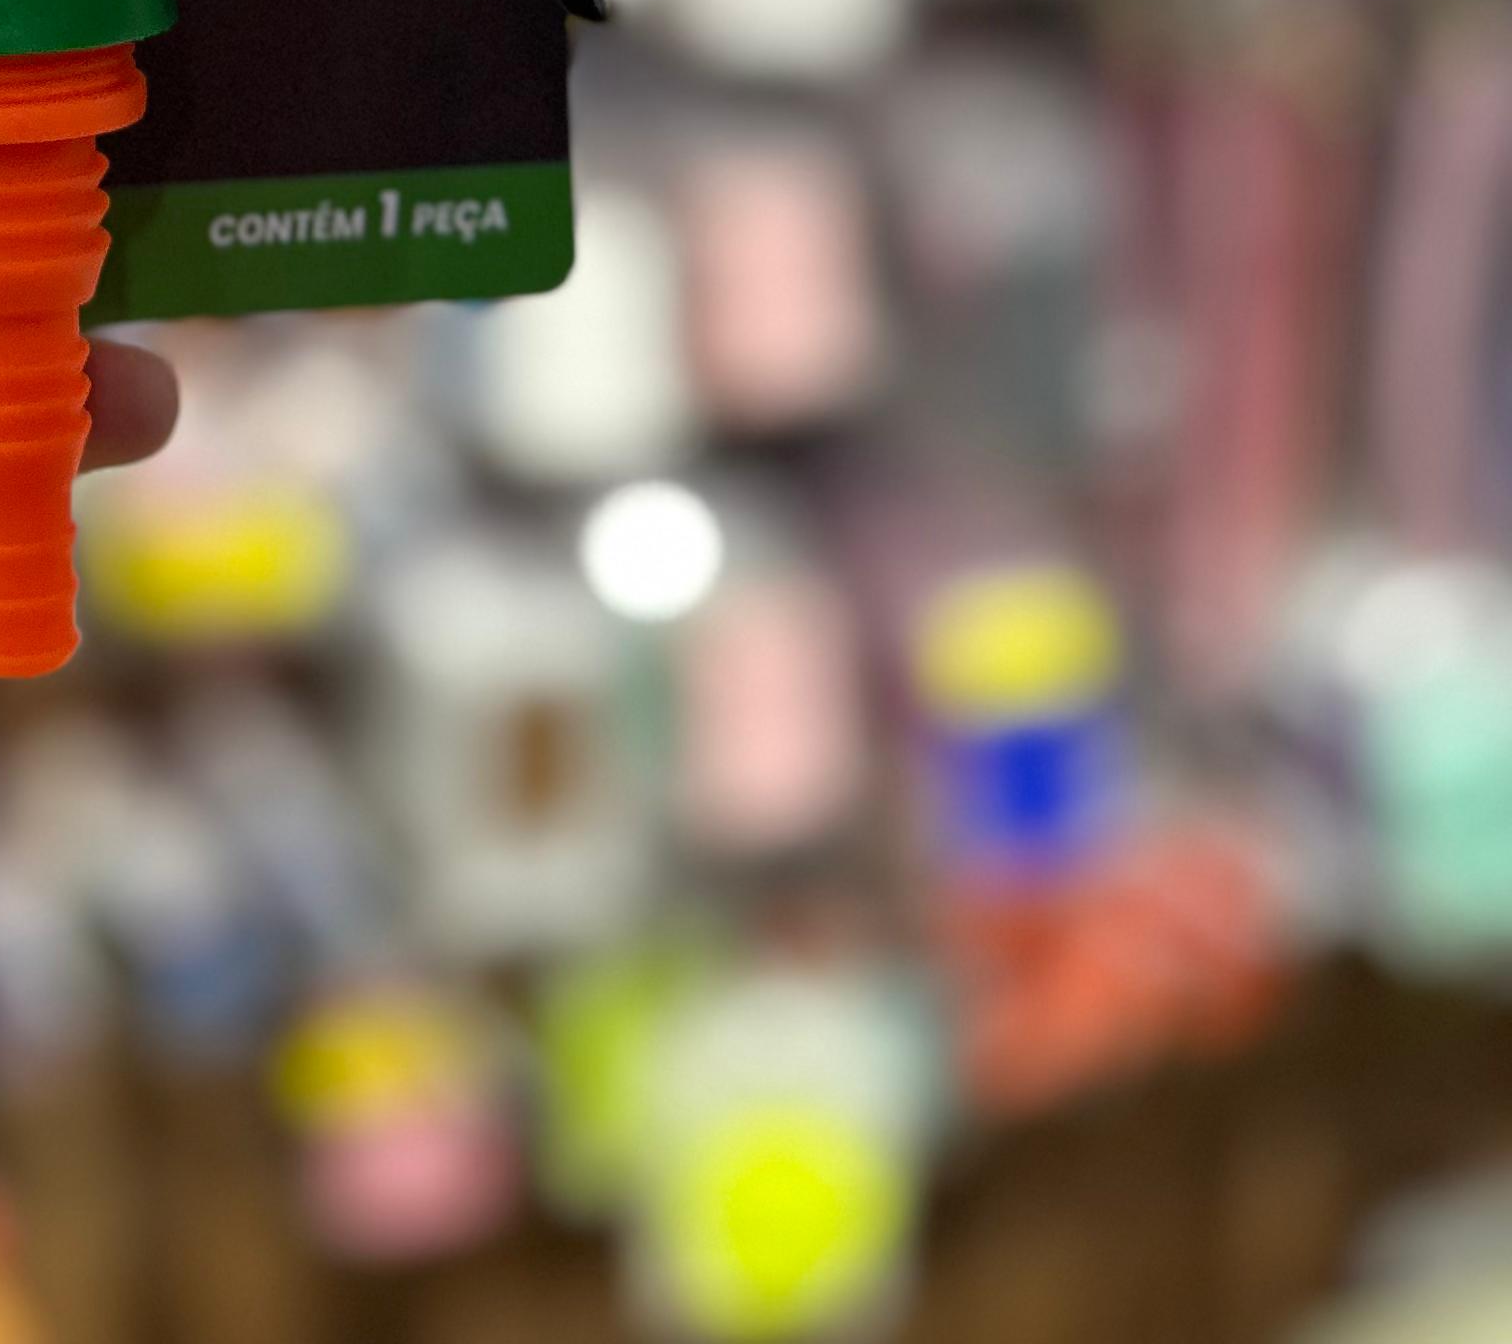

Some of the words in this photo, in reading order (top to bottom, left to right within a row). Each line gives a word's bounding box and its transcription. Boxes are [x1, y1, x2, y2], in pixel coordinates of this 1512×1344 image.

[208, 200, 367, 248] CONTÉM
[379, 189, 401, 239] 1
[412, 198, 509, 244] PEÇA
